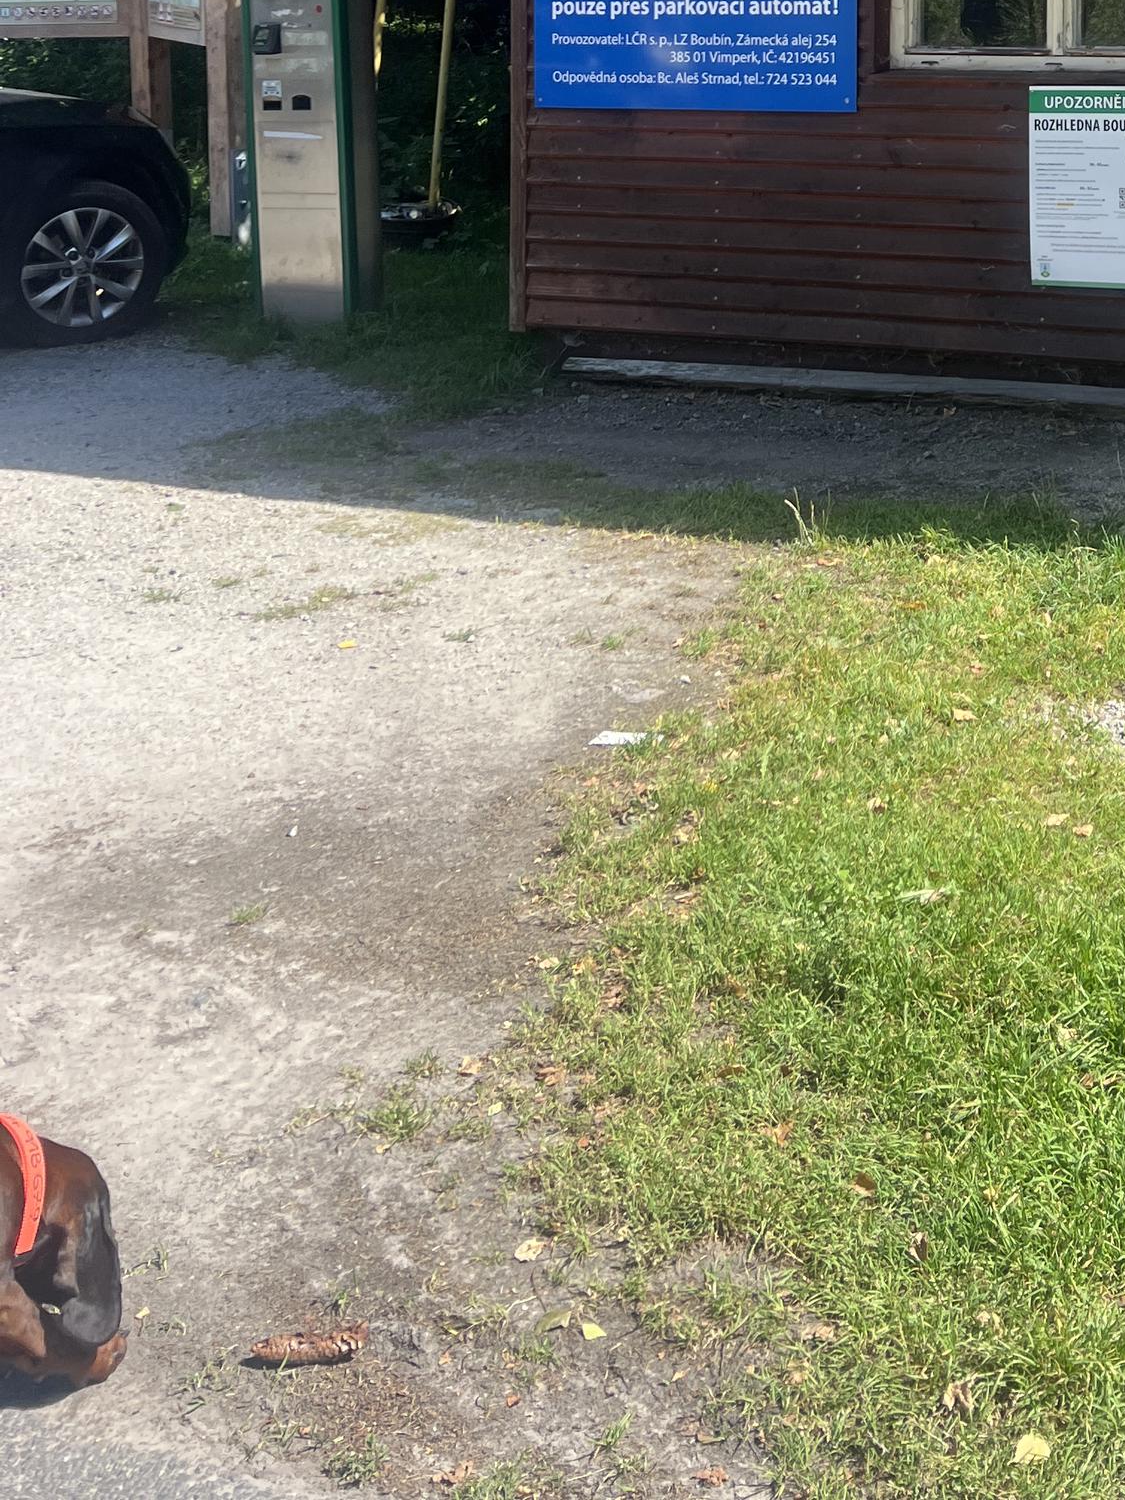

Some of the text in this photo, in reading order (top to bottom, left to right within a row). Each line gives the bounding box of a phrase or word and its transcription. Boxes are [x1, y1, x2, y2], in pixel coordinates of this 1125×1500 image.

[552, 0, 606, 20] pouze
[552, 33, 624, 45] Provozovatel:
[625, 31, 647, 45] LČR
[674, 34, 688, 45] LZ
[690, 33, 735, 47] Boubín,
[736, 33, 789, 46] Zámecká
[791, 33, 812, 49] alej
[815, 34, 837, 46] 254
[670, 49, 836, 65] 385 01 Vimperk, IČ: 42196451
[552, 71, 617, 85] Odpovědná
[619, 72, 656, 84] osoba:
[657, 72, 674, 84] Bc.
[675, 72, 700, 85] Aleš
[701, 72, 742, 86] Strnad,
[766, 73, 788, 85] 724
[791, 73, 812, 85] 523
[815, 73, 838, 85] 044
[1034, 119, 1100, 132] ROZHLEDNA
